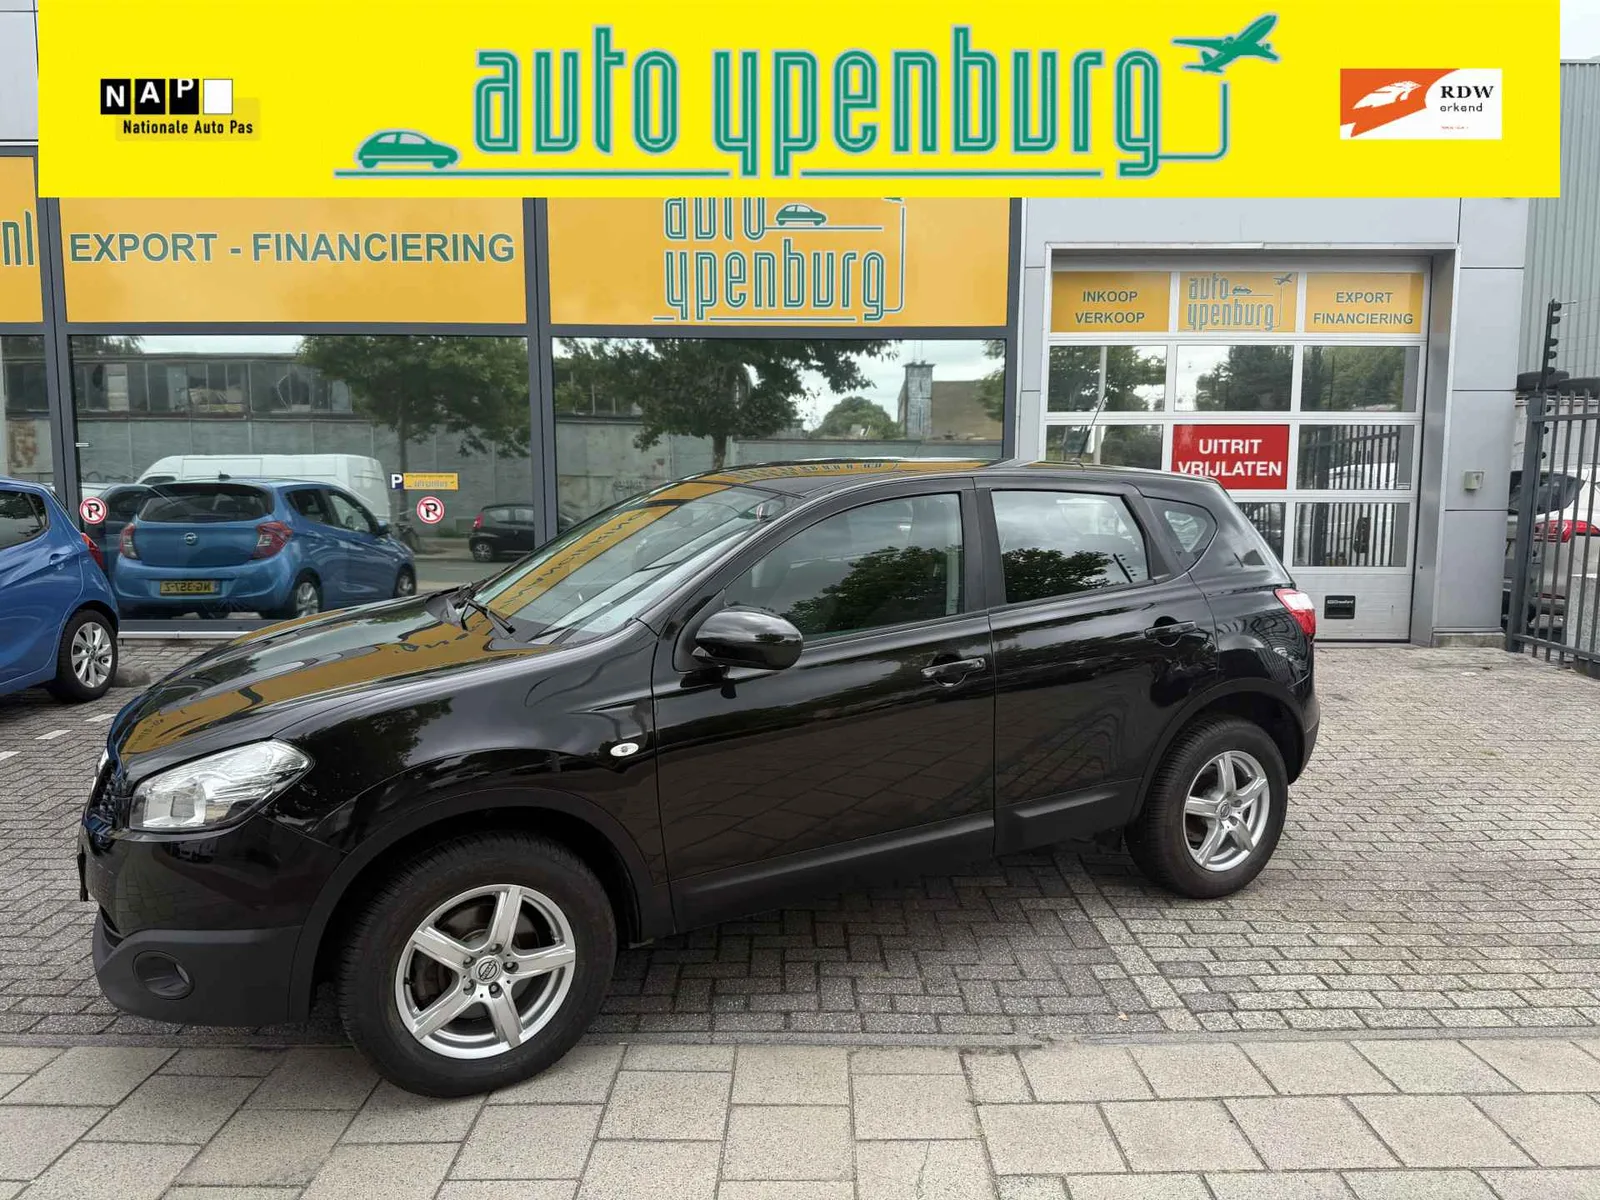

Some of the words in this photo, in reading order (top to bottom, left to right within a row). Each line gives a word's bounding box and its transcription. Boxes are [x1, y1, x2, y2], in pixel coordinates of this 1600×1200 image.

[69, 232, 218, 263] EXPORT
[229, 245, 242, 256] -
[251, 232, 516, 264] FINANCIERING
[664, 238, 886, 321] ypenburg
[1188, 272, 1229, 300] auto
[1082, 290, 1138, 303] INKOOP
[1335, 291, 1393, 304] EXPORT
[1074, 311, 1145, 325] VERKOOP
[1187, 299, 1274, 331] ypenburg
[1313, 312, 1414, 325] FINANCIERING
[1199, 438, 1262, 455] UITRIT
[1177, 460, 1282, 477] VRIJLATEN
[391, 473, 404, 489] P
